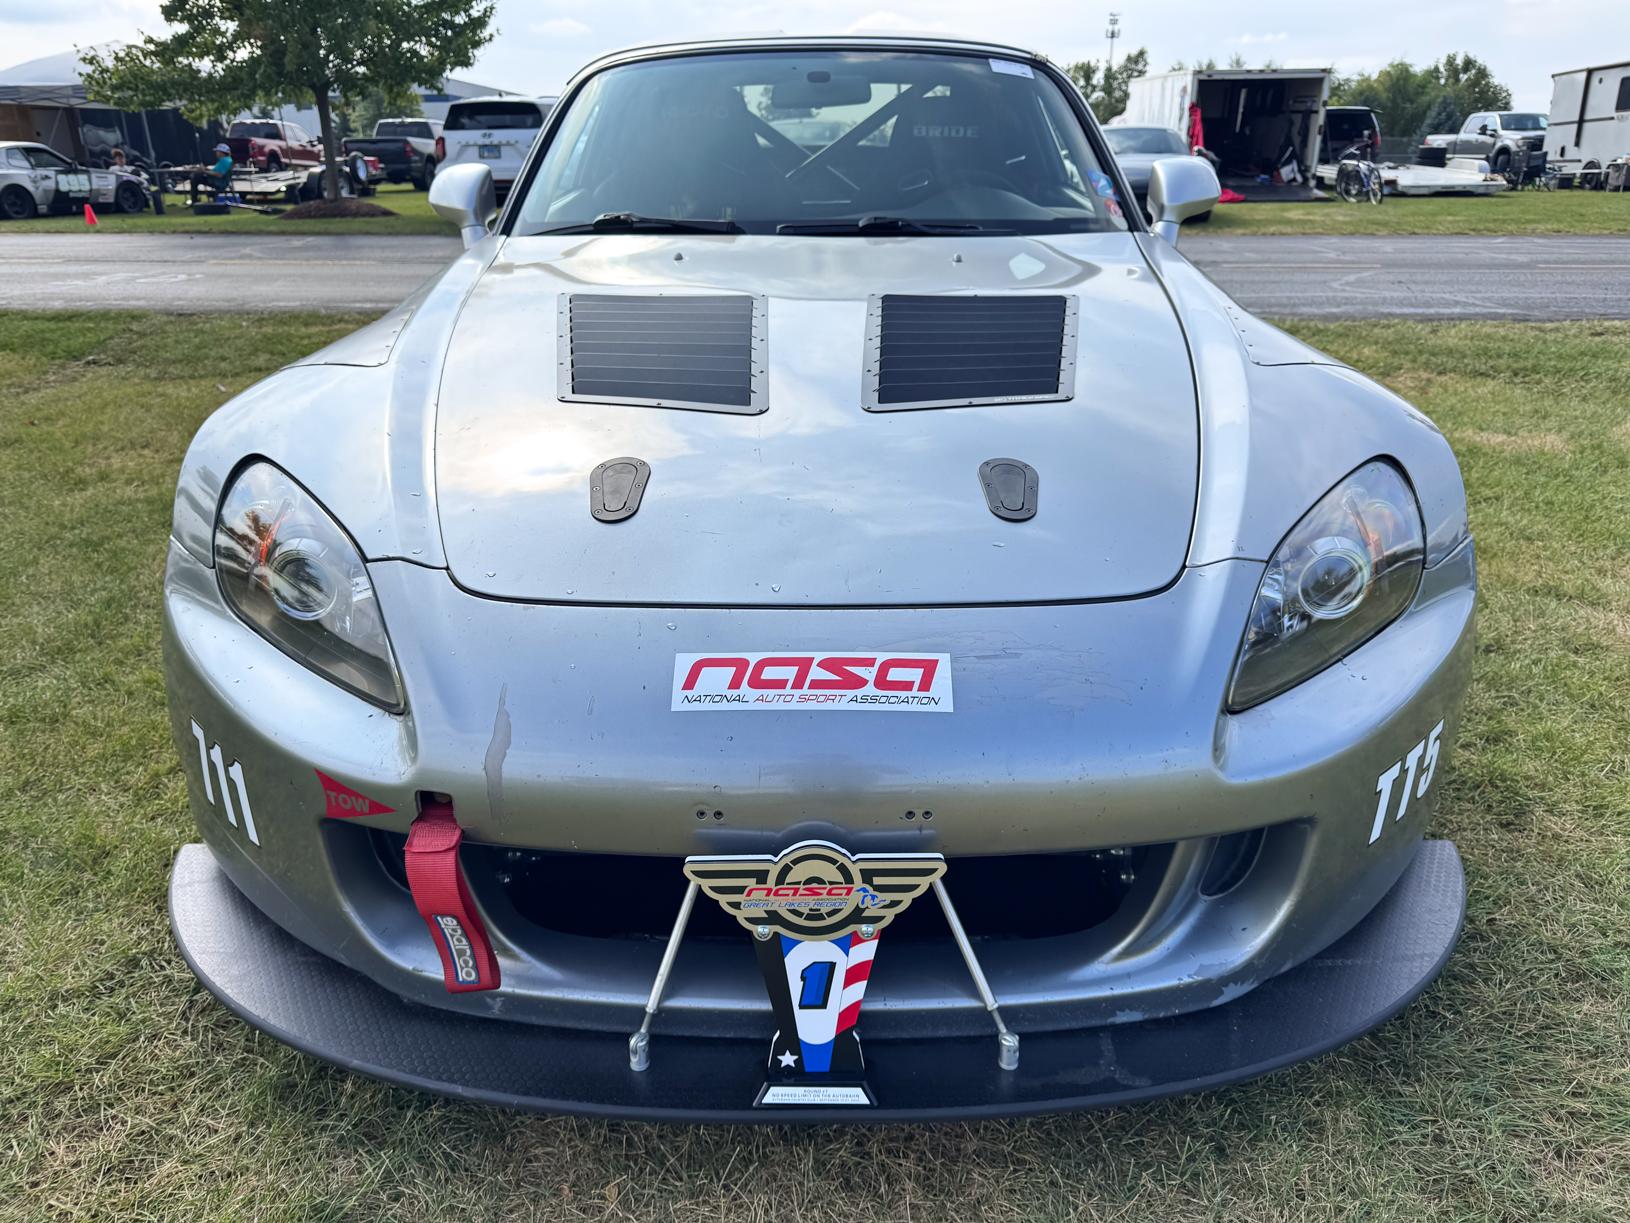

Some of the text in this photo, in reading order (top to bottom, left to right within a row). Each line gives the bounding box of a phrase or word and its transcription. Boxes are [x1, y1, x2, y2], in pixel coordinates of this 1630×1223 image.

[913, 125, 979, 138] BRIDE
[681, 694, 941, 706] NATIONAL AUTO SPORT ASSOCIATION
[1368, 718, 1444, 845] TT5
[326, 789, 369, 814] TOW
[743, 901, 774, 909] GREAT
[442, 917, 476, 981] sparco
[799, 961, 836, 1009] 1
